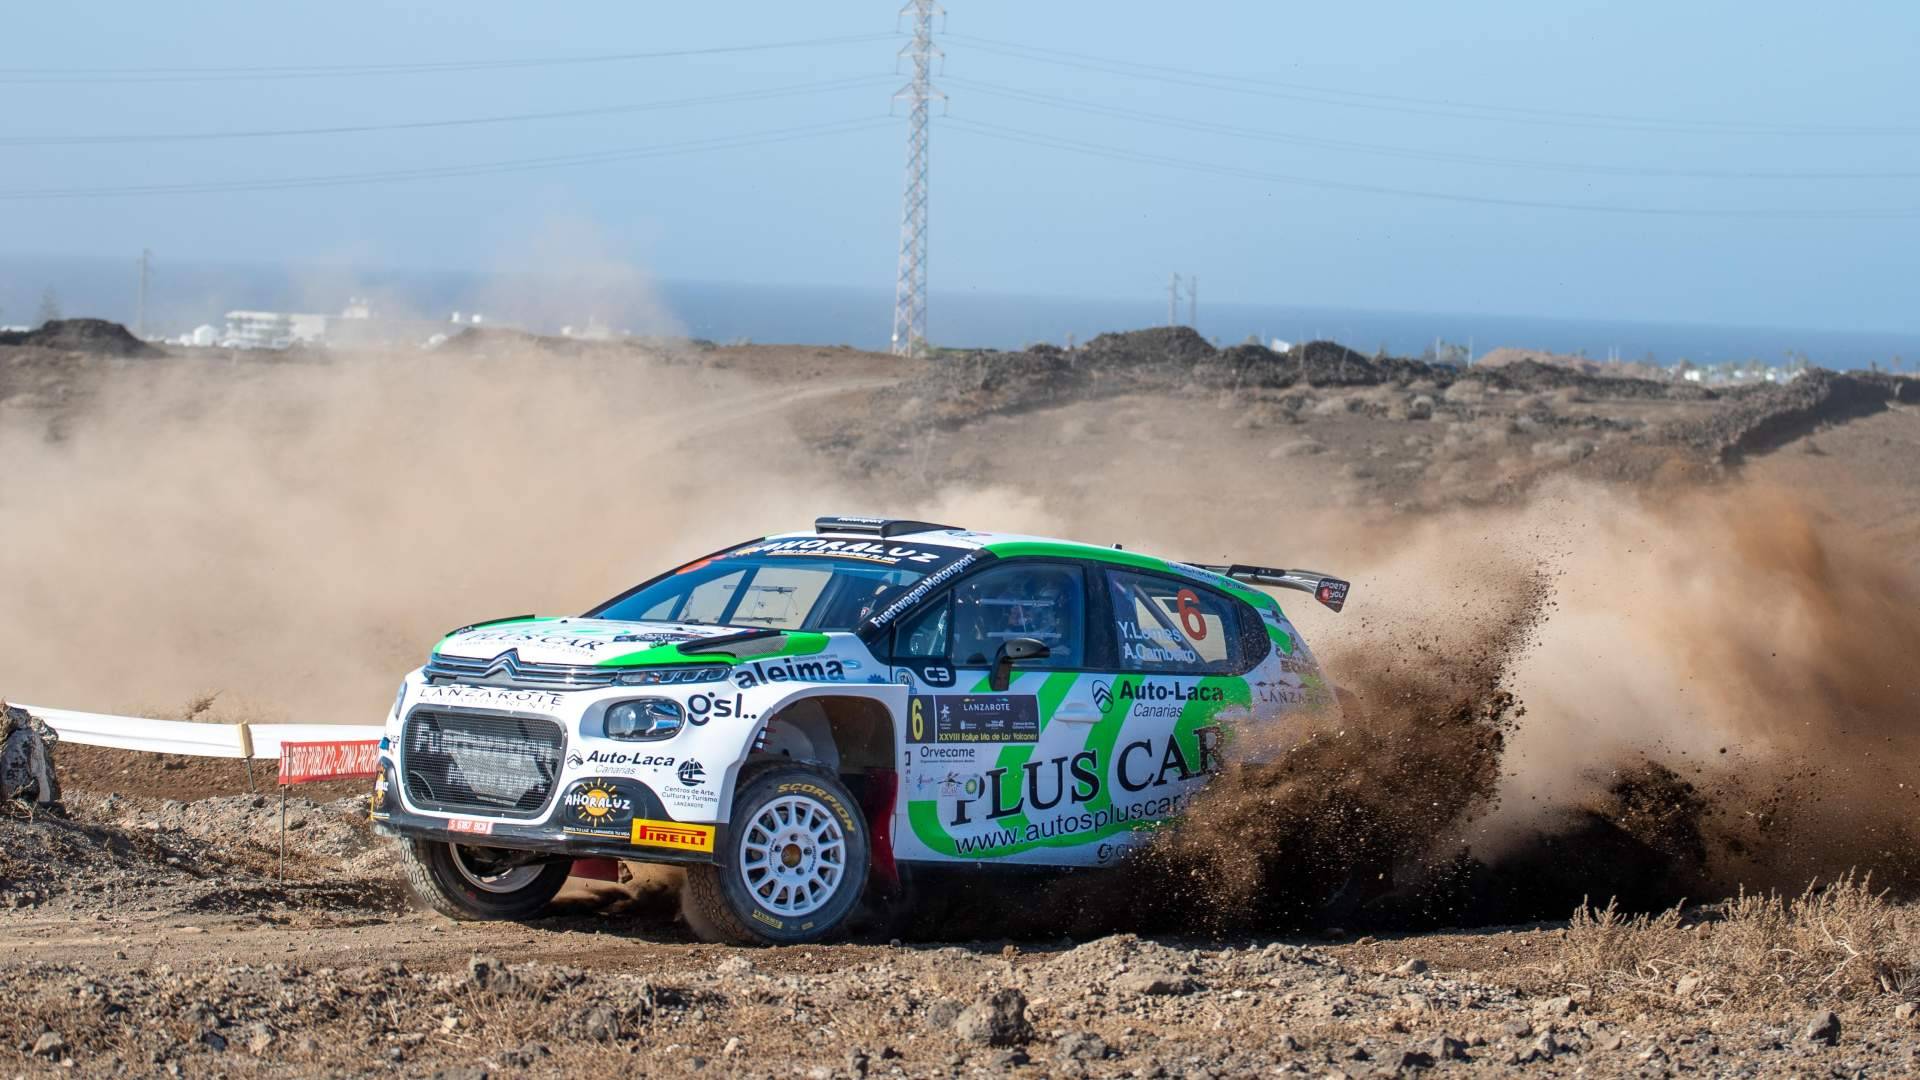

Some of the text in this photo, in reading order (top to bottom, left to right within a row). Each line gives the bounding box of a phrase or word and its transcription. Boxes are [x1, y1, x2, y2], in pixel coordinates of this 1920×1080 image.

[1176, 588, 1207, 641] 6
[735, 658, 846, 690] aleima
[923, 667, 951, 681] C3
[419, 688, 565, 706] LANZAROTE
[1119, 680, 1224, 701] Auto-Laca
[963, 703, 1010, 711] LANZAROTE
[1133, 703, 1183, 718] Canarias
[911, 698, 924, 741] 6
[587, 750, 675, 767] Auto-Laca
[920, 745, 975, 758] Orvecame
[595, 764, 636, 775] Canarias
[662, 791, 685, 800] Cultura
[692, 795, 718, 803] Turismo
[665, 785, 689, 795] Centros
[564, 794, 631, 810] AHORALUZ
[777, 783, 856, 832] SCORPION
[640, 825, 707, 846] PIRELLI
